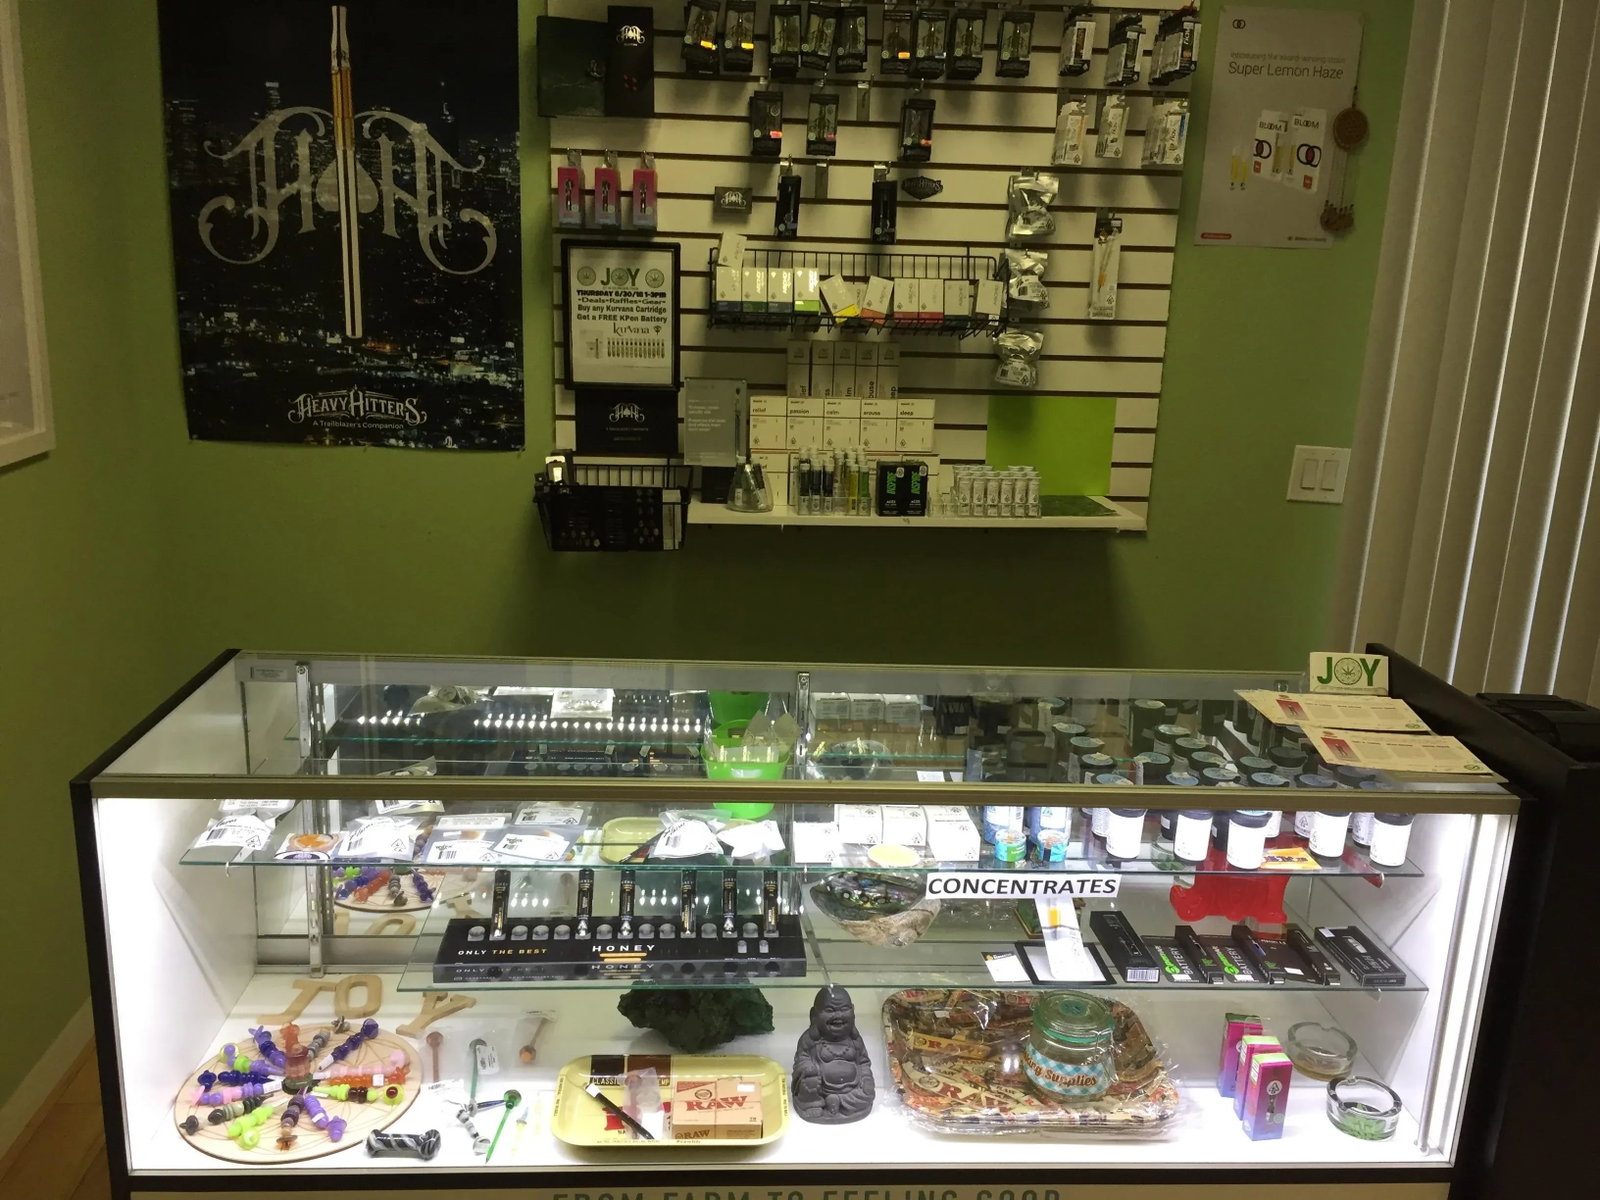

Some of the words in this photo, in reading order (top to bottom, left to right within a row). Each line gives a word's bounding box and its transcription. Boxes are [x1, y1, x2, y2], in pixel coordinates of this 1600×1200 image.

[1229, 61, 1264, 77] Super
[1267, 64, 1309, 77] Lemon
[1313, 66, 1344, 79] Haze
[601, 267, 640, 286] JOY
[577, 289, 613, 297] THURSDAY
[636, 306, 667, 315] Cartridge
[288, 393, 348, 424] HEAVY
[349, 387, 427, 426] HITTERS
[1317, 657, 1381, 686] JOY
[928, 878, 1117, 895] CONCENTRATES
[1044, 1069, 1097, 1087] Supplies
[686, 1096, 748, 1111] RAW
[684, 1129, 710, 1140] RAW
